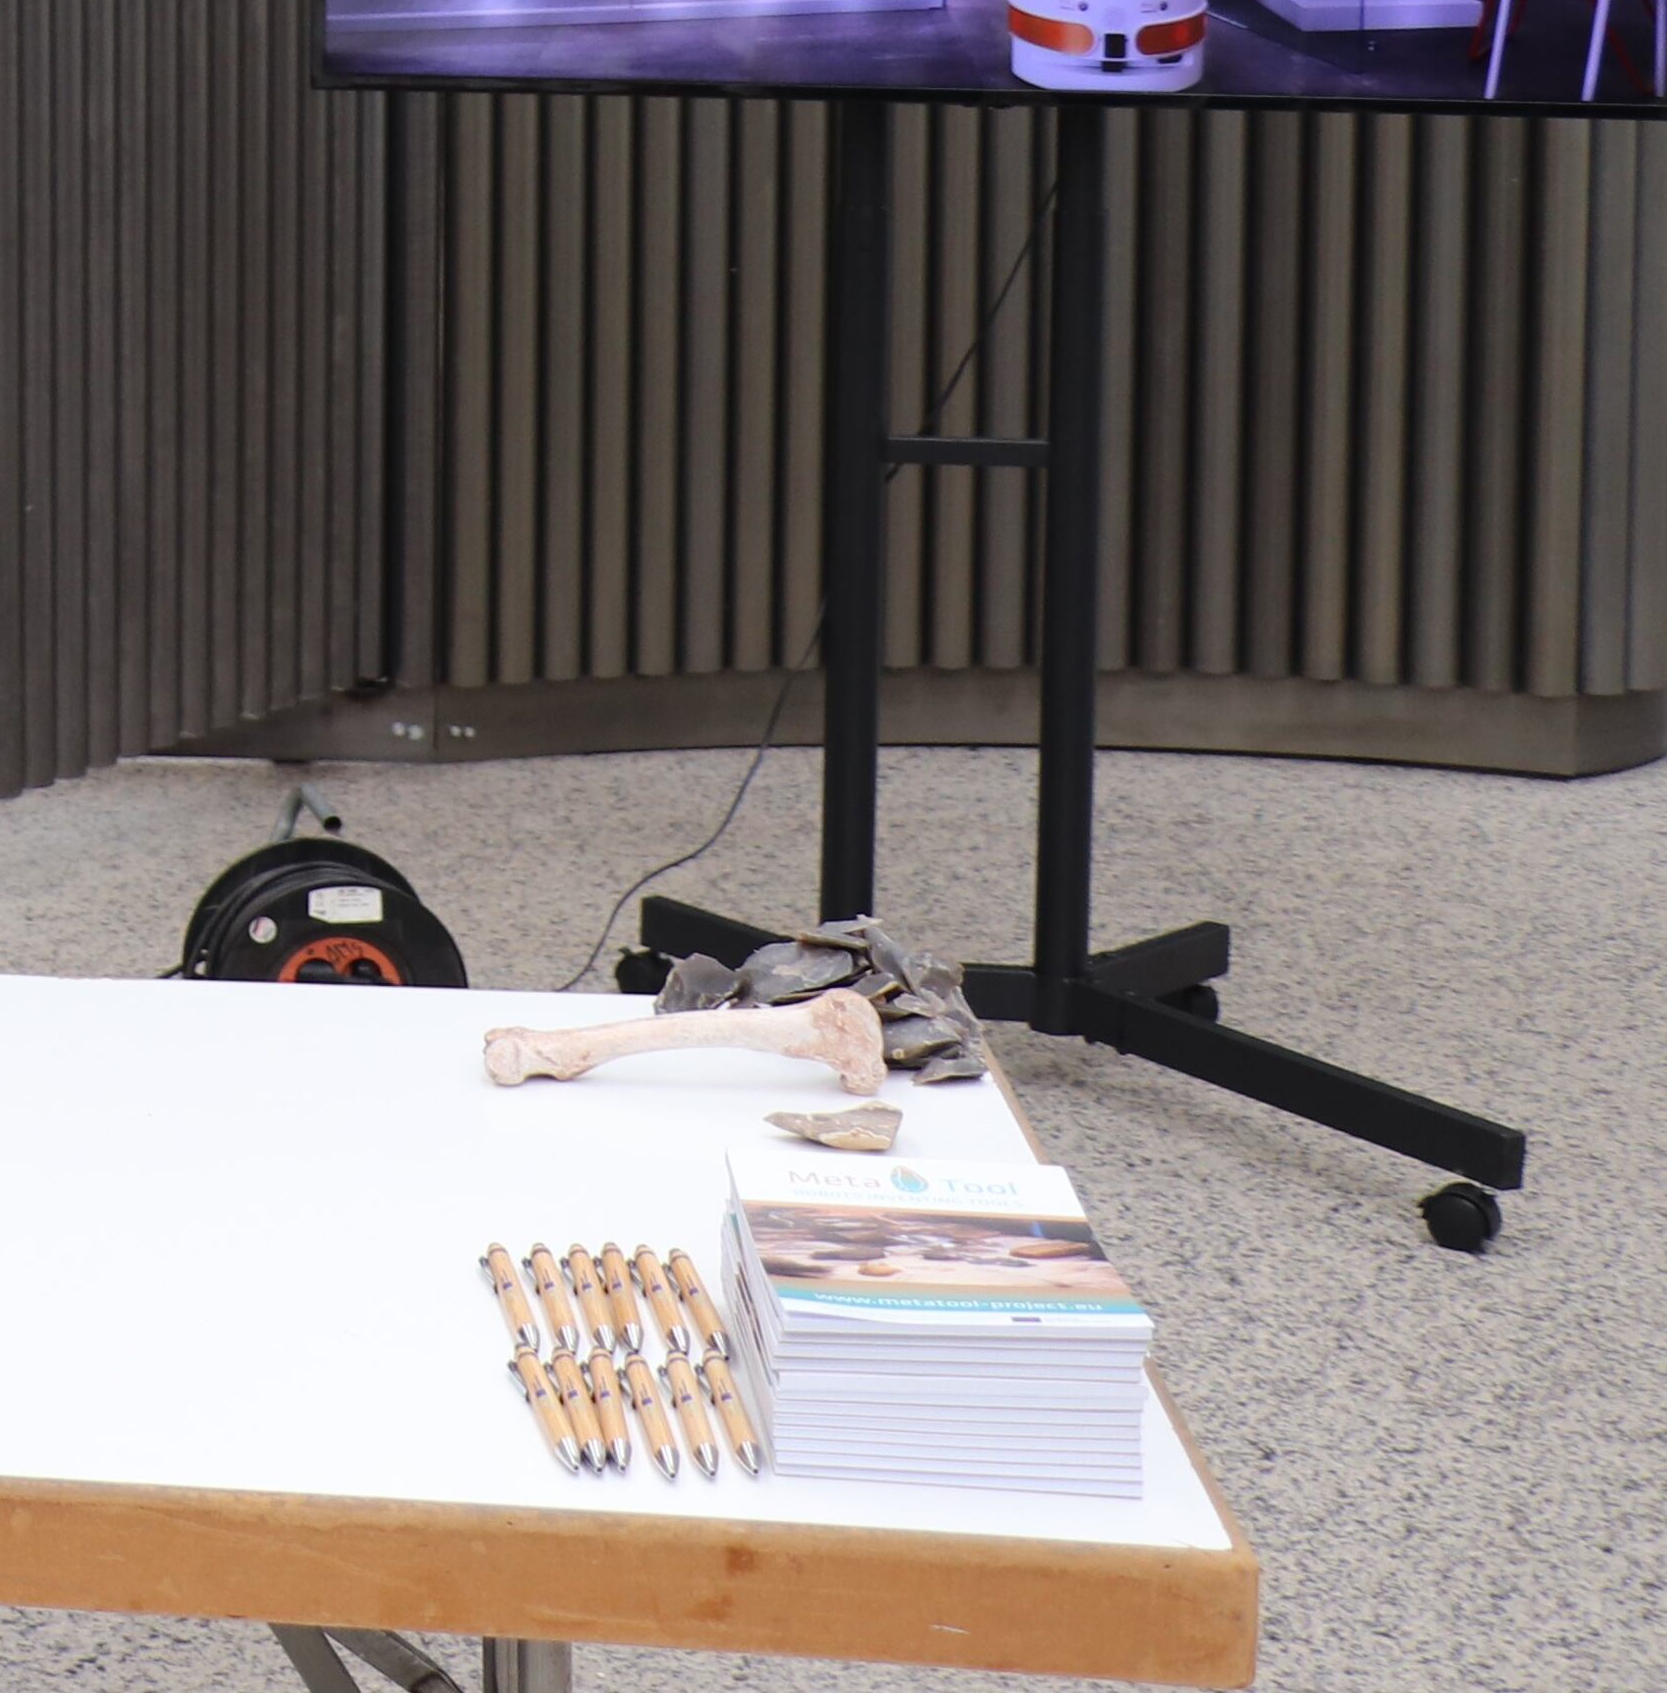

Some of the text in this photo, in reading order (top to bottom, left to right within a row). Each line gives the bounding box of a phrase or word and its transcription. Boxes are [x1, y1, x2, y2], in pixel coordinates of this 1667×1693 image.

[787, 1168, 1019, 1196] Meta Tool
[813, 1290, 1104, 1313] www.metatool-project.eu
